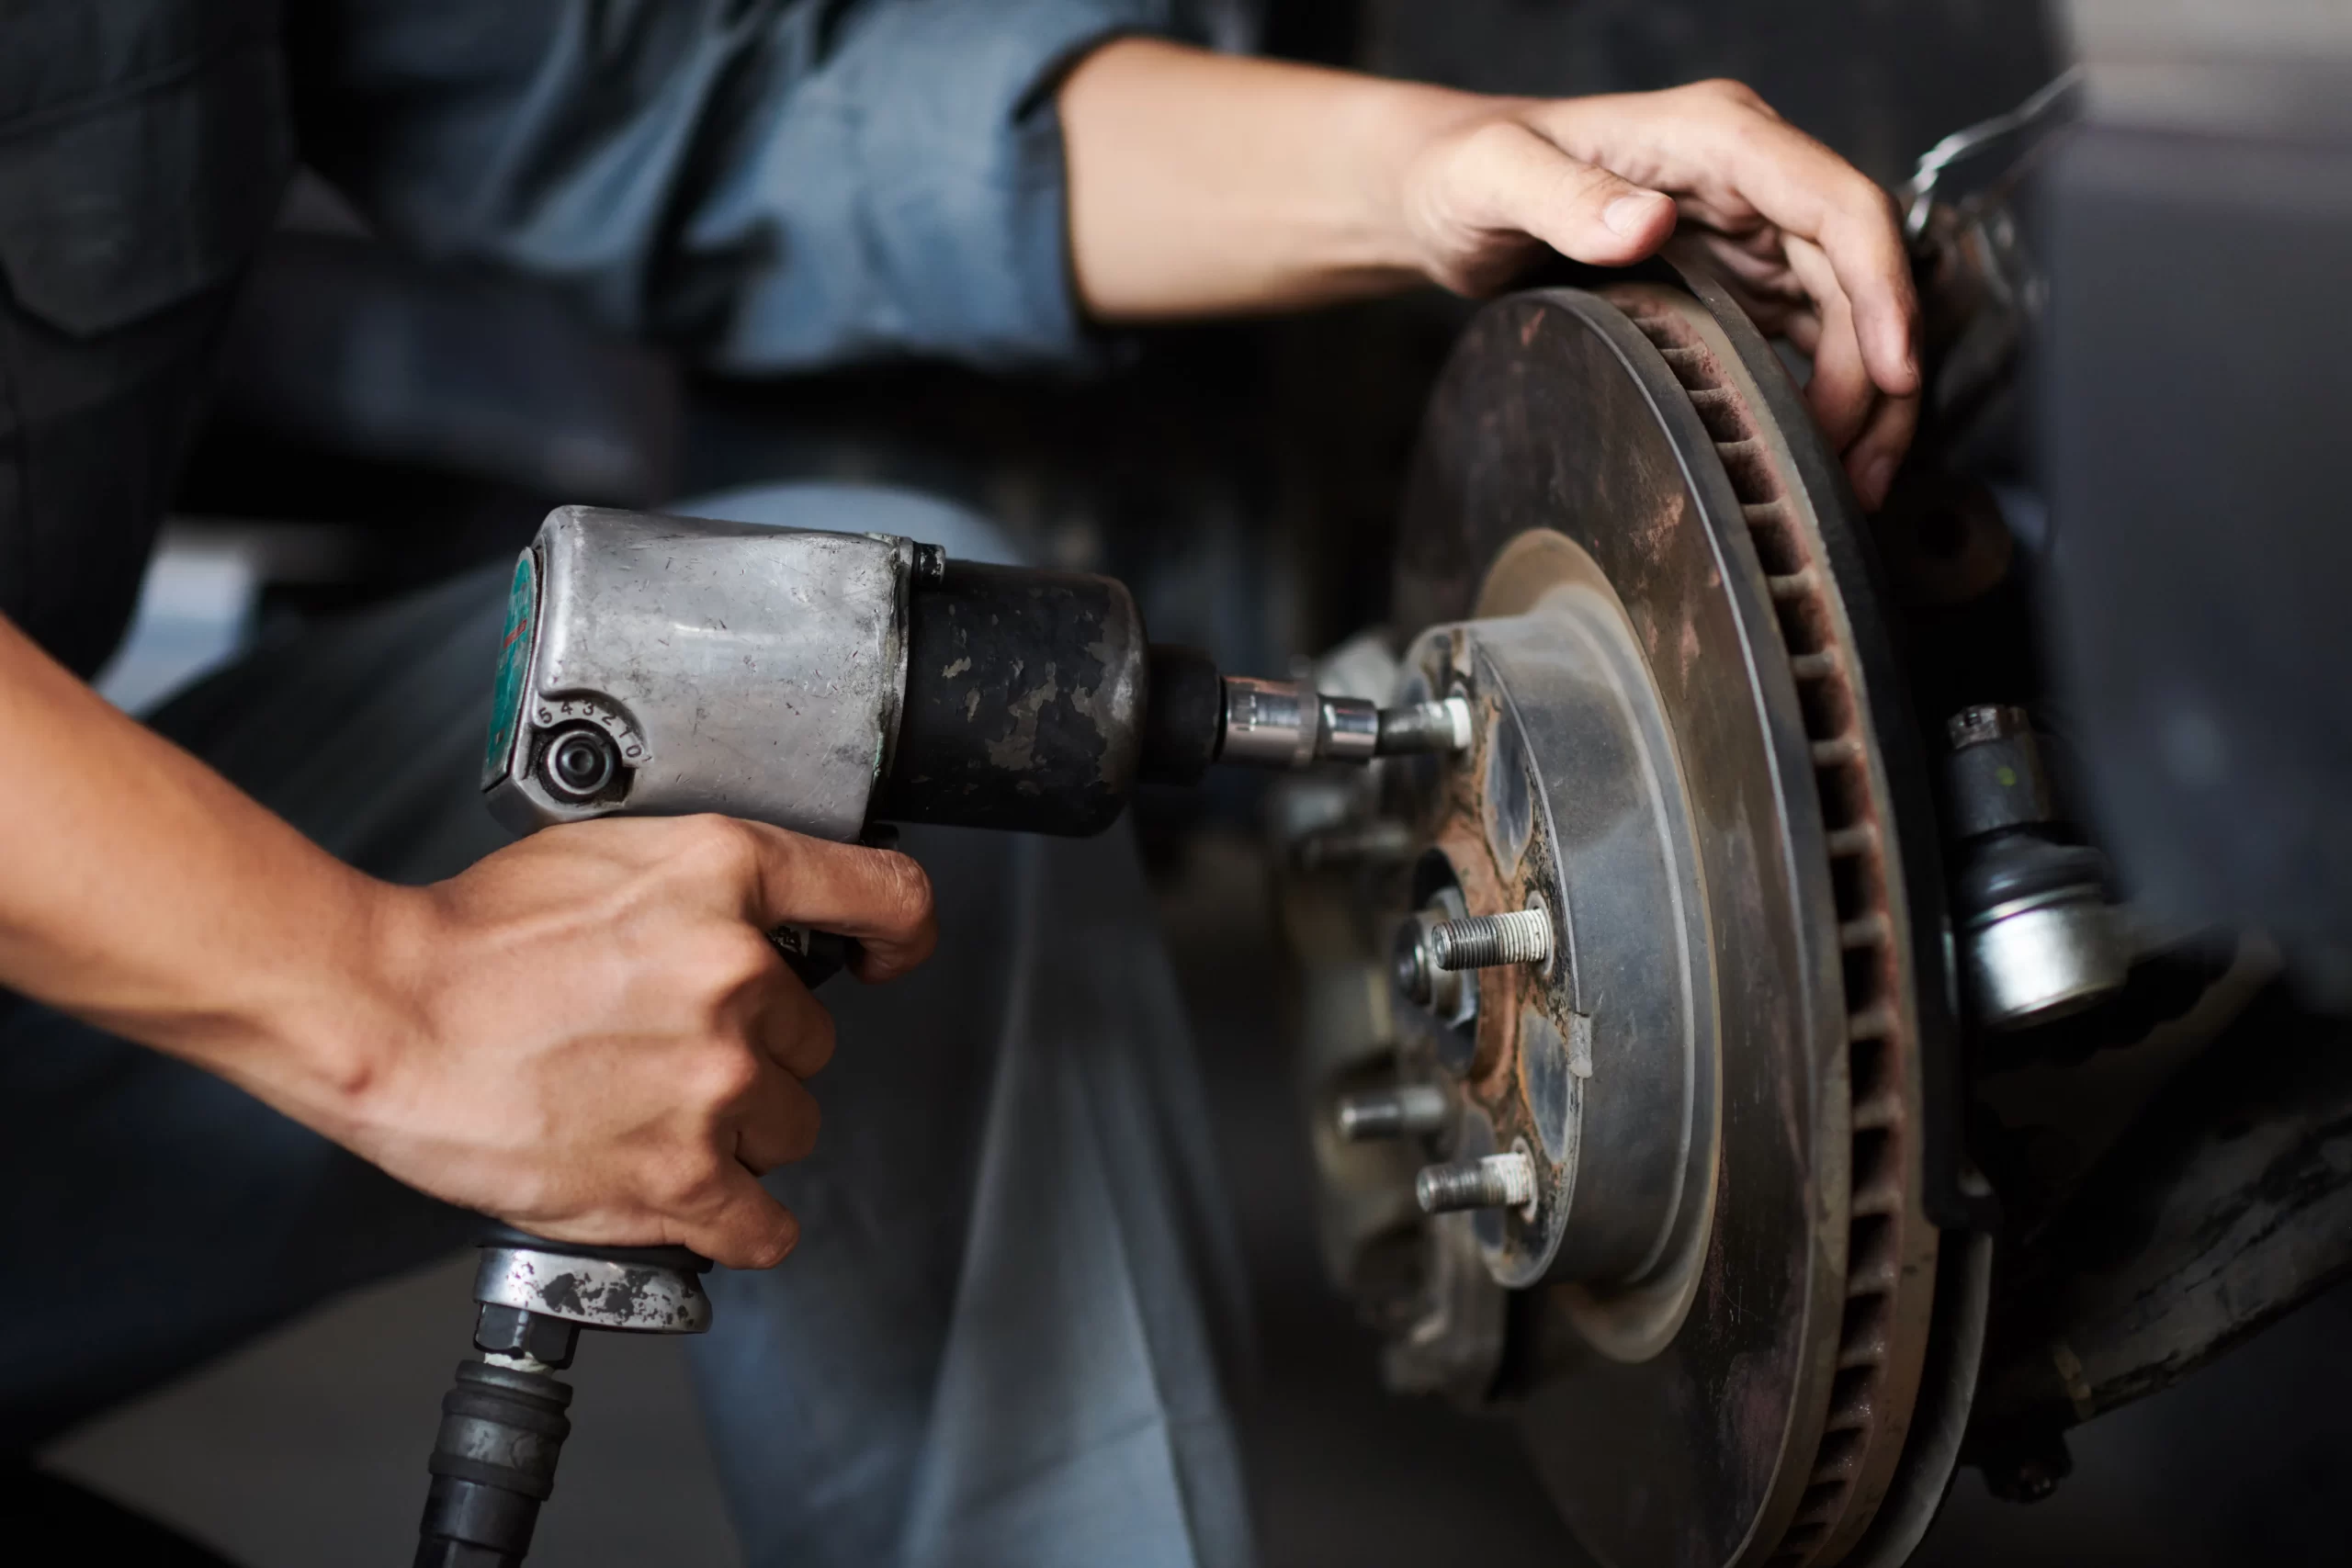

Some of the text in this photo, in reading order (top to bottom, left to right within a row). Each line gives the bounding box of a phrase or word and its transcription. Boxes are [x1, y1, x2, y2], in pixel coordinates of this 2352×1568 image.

[538, 707, 553, 724] 5
[560, 701, 573, 716] 4
[582, 701, 594, 716] 3
